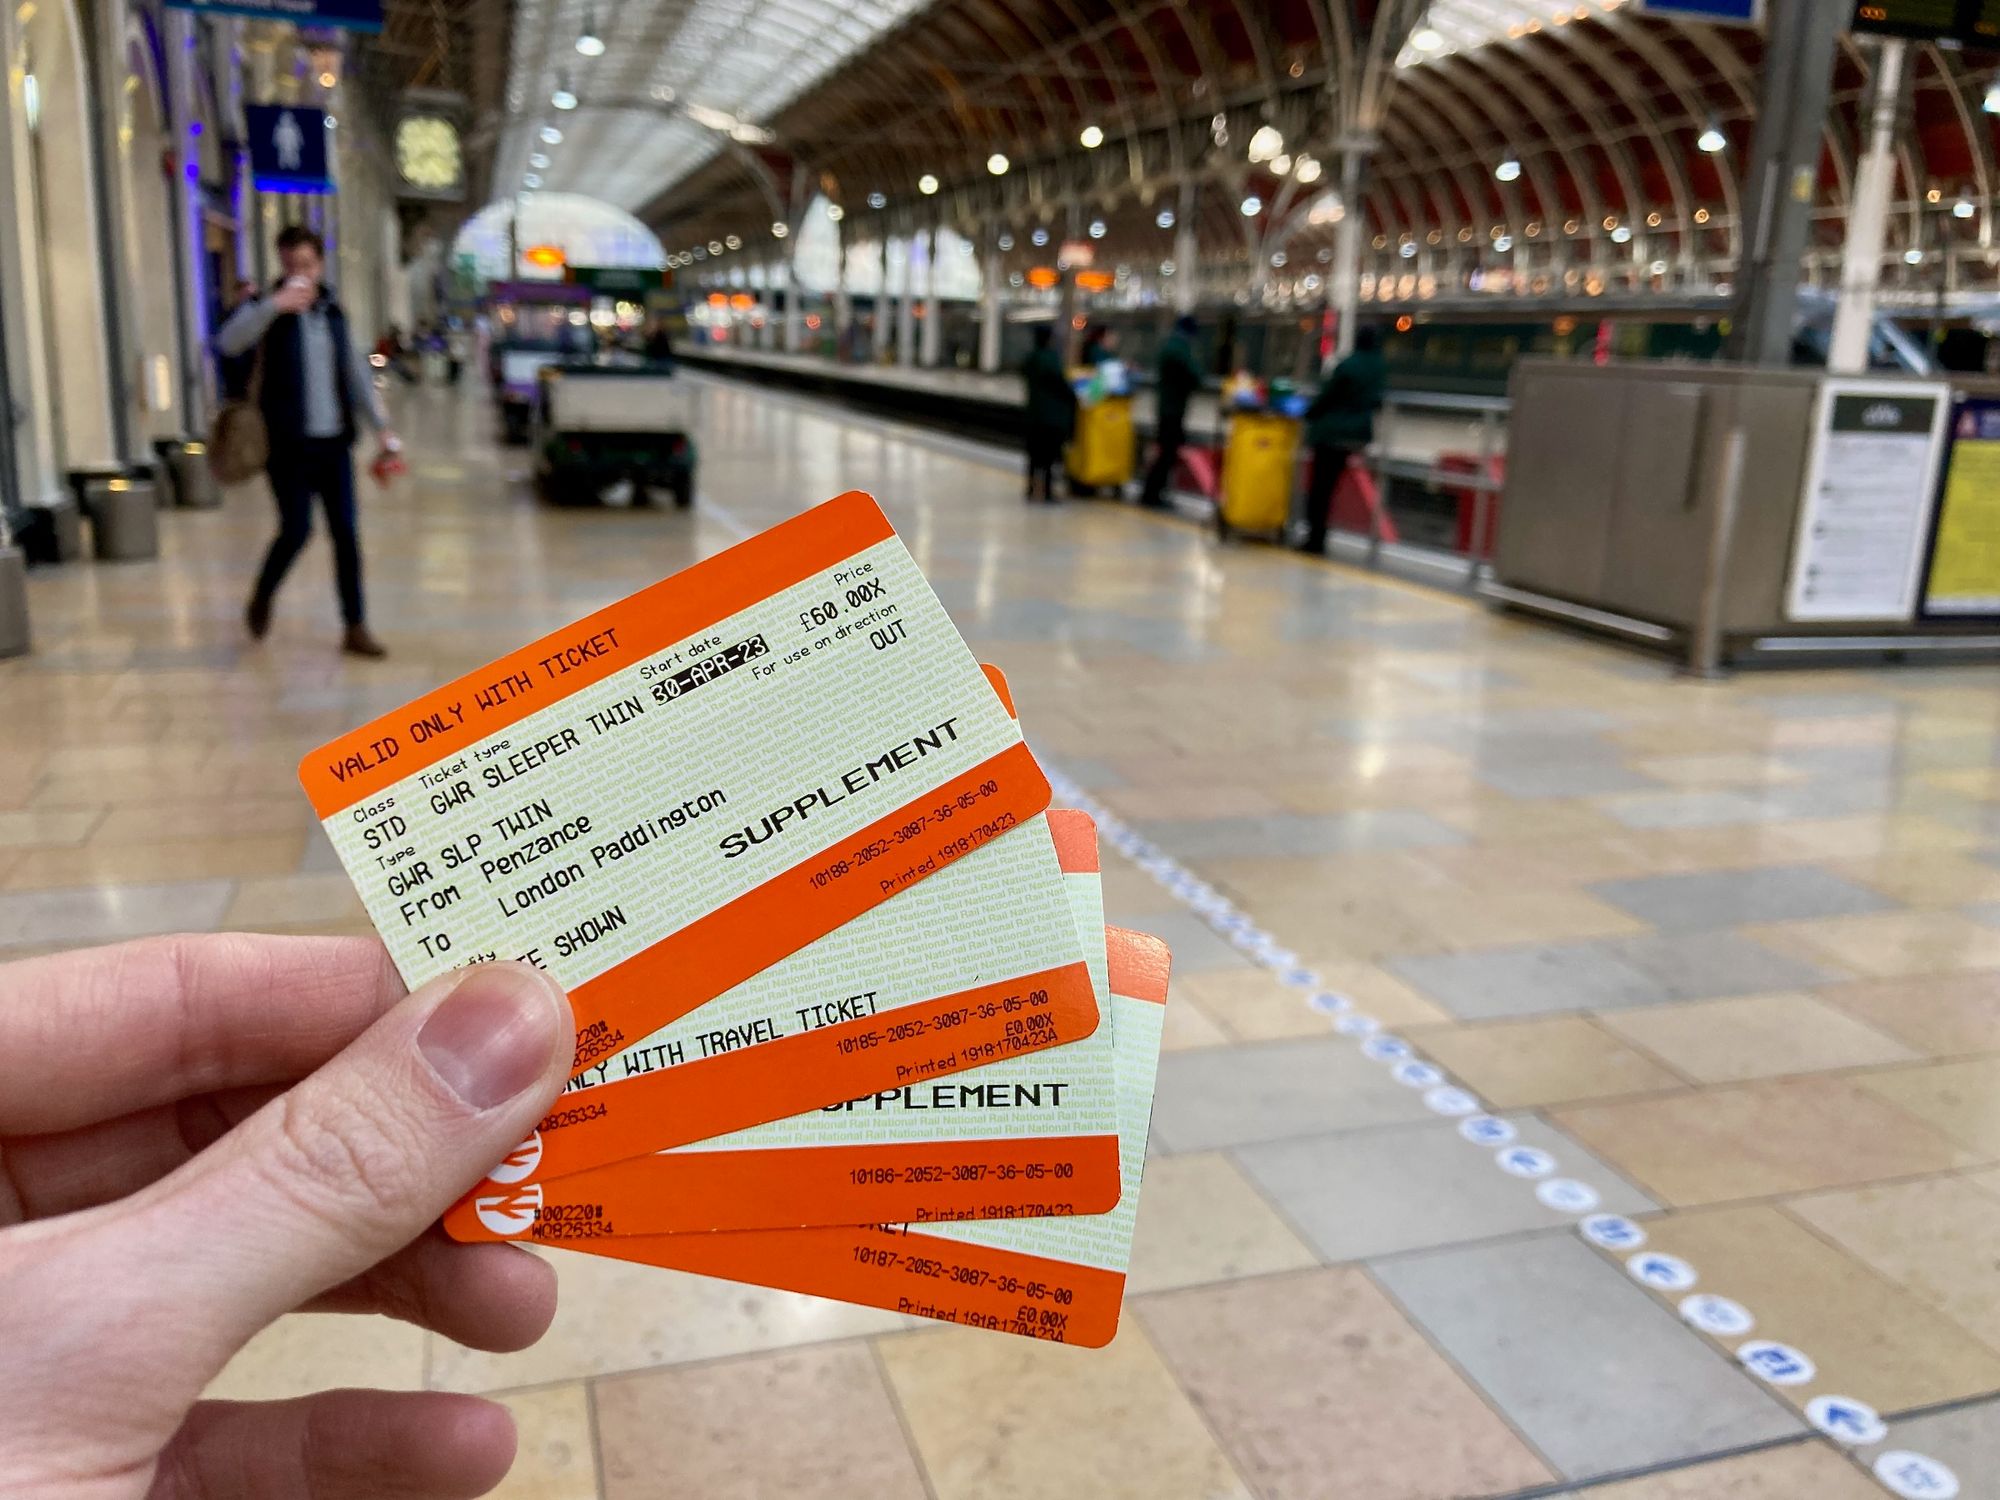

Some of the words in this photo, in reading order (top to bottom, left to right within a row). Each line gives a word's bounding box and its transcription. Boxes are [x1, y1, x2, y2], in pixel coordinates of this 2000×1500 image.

[834, 562, 873, 586] Price
[800, 577, 887, 633] £60.00X
[640, 650, 683, 680] Start
[688, 634, 722, 659] date
[752, 662, 777, 681] For
[784, 645, 812, 666] use
[815, 636, 833, 651] on
[835, 602, 898, 641] direction
[869, 618, 908, 651] OUT
[329, 736, 400, 782] VALID
[409, 702, 463, 744] ONLY
[474, 670, 533, 712] WITH
[539, 627, 620, 680] TICKET
[363, 815, 407, 850] STD
[430, 780, 475, 815] GWR
[482, 728, 580, 789] SLEEPER
[586, 695, 645, 736] TWIN
[649, 634, 770, 706] 30-APR-23
[353, 797, 396, 823] Class
[418, 757, 468, 790] Ticket
[473, 738, 511, 764] type
[719, 717, 958, 860] SUPPLEMENT
[376, 845, 416, 871] Type
[387, 861, 433, 897] GWR
[440, 833, 482, 869] SLP
[492, 798, 553, 842] TWIN
[808, 780, 998, 891] 10188-2052-3087-36-05-00
[400, 884, 462, 926] From
[480, 815, 592, 883] Penzance
[418, 933, 451, 959] To
[498, 862, 585, 918] London
[590, 787, 727, 869] Paddington
[880, 856, 937, 894] Printed
[554, 905, 627, 957] SHOWN
[624, 1041, 684, 1077] WITH
[696, 1018, 783, 1058] TRAVEL
[796, 991, 877, 1031] TICKET
[836, 989, 1048, 1055] 10185-2052-3087-36-05-00
[896, 1055, 956, 1080] Printed
[850, 1163, 1073, 1184] 10186-2052-3087-36-05-00
[916, 1208, 974, 1221] Printed
[853, 1246, 1073, 1304] 10187-2052-3087-36-05-00
[898, 1297, 957, 1323] Printed
